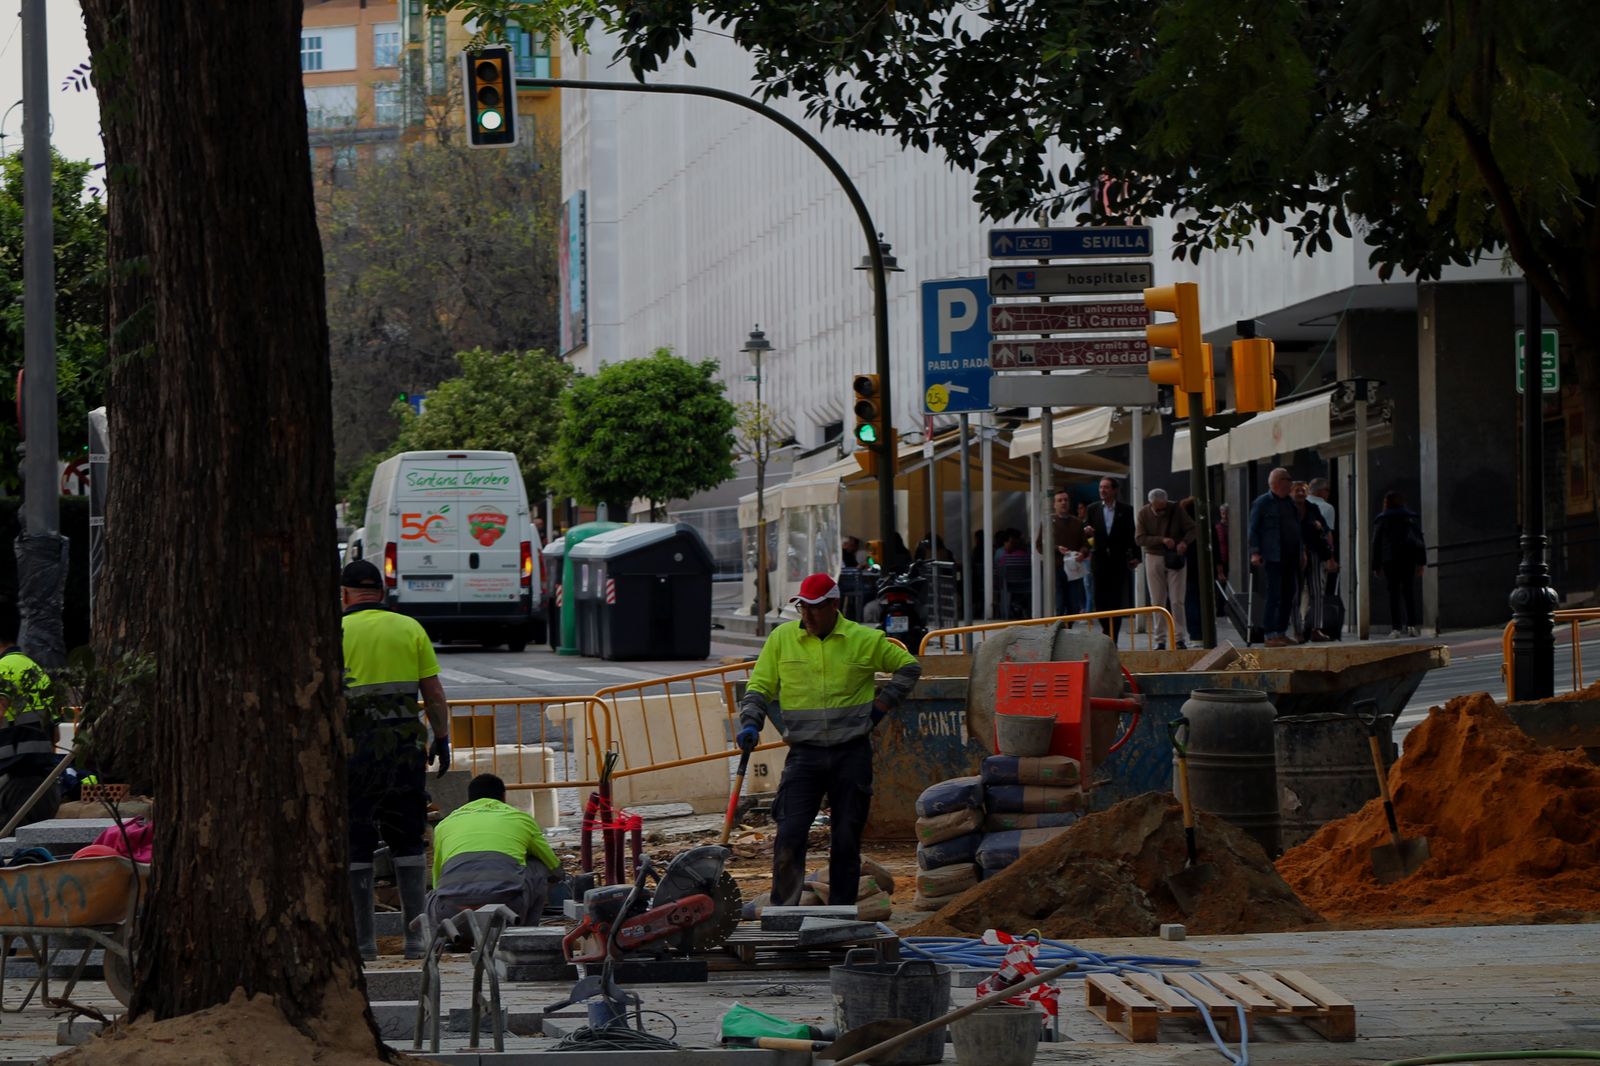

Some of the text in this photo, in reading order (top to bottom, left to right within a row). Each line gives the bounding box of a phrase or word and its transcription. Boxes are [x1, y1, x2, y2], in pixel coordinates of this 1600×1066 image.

[1082, 235, 1145, 249] SEVILLA
[1067, 271, 1147, 286] hospitales
[1084, 304, 1147, 313] universidad
[938, 287, 978, 354] P
[1067, 314, 1147, 328] El Carmen
[1093, 341, 1147, 350] ermita de
[927, 358, 990, 371] PABLO RADA
[1059, 351, 1147, 365] La Soledad
[406, 472, 510, 487] Santana Cordero
